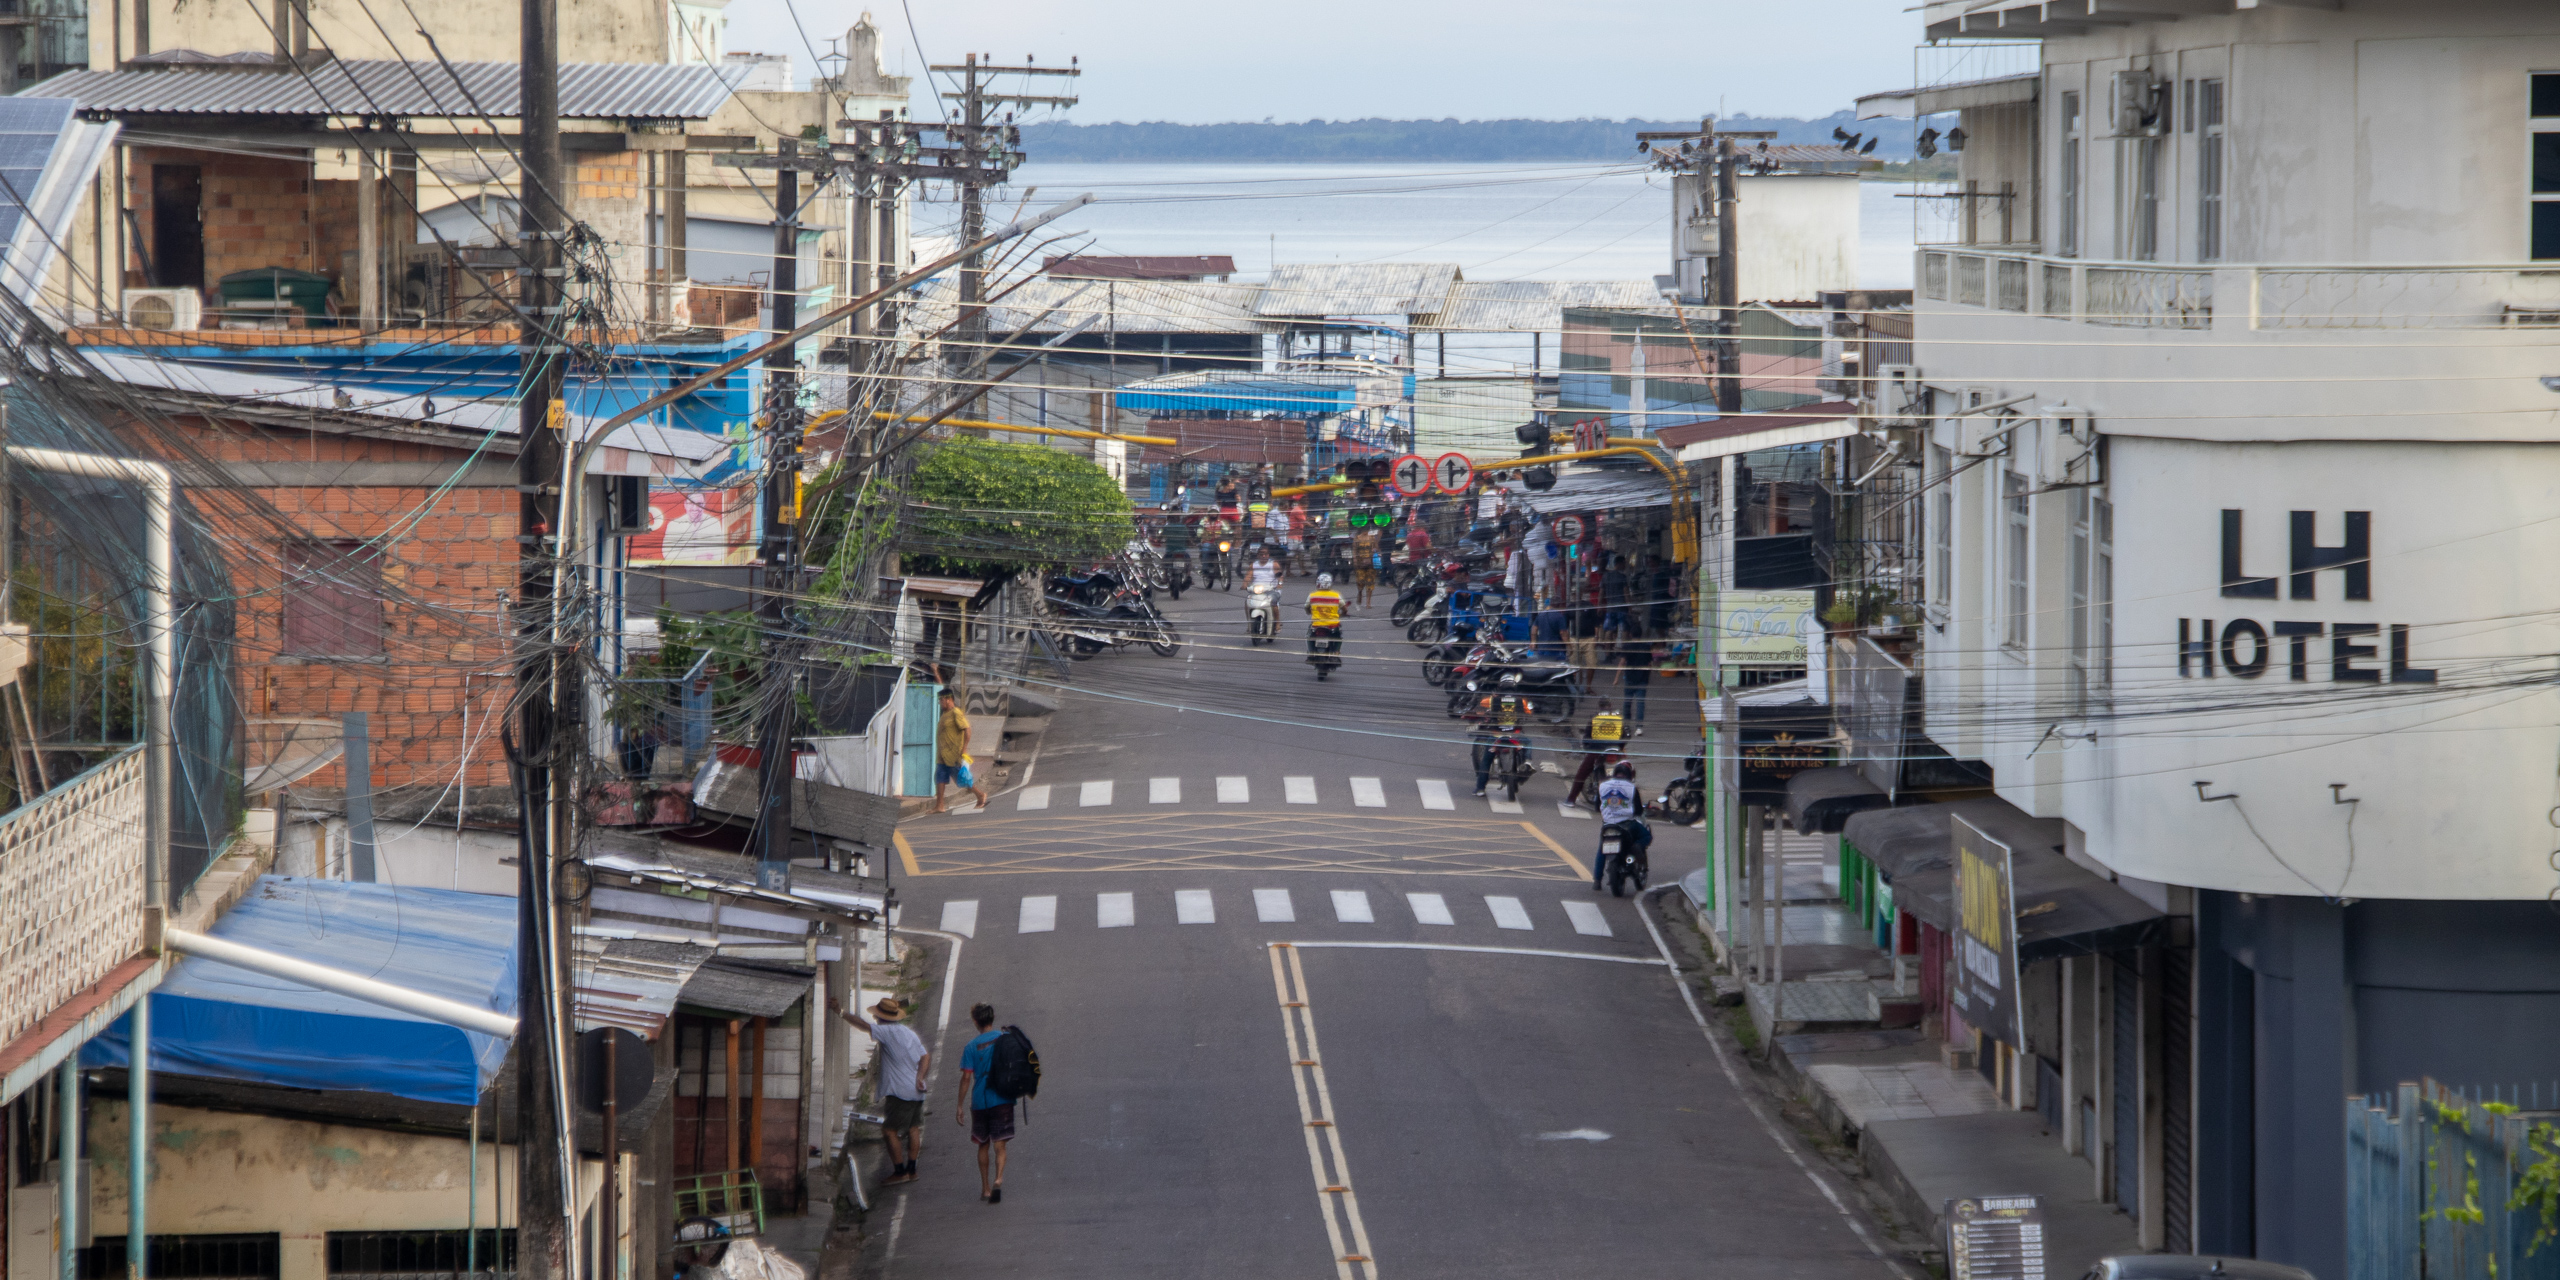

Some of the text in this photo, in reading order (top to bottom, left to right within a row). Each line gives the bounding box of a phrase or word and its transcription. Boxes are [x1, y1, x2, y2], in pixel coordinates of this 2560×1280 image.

[1561, 520, 1576, 539] E
[2221, 508, 2371, 601] LH
[1755, 594, 1814, 607] Drog
[1726, 605, 1790, 645] Viva
[1726, 651, 1744, 660] DISK
[1744, 651, 1761, 660] VIVA
[1780, 651, 1792, 661] 97
[2178, 617, 2438, 684] HOTEL
[1780, 753, 1824, 768] Modas
[1982, 1198, 2036, 1211] BARBEARIA
